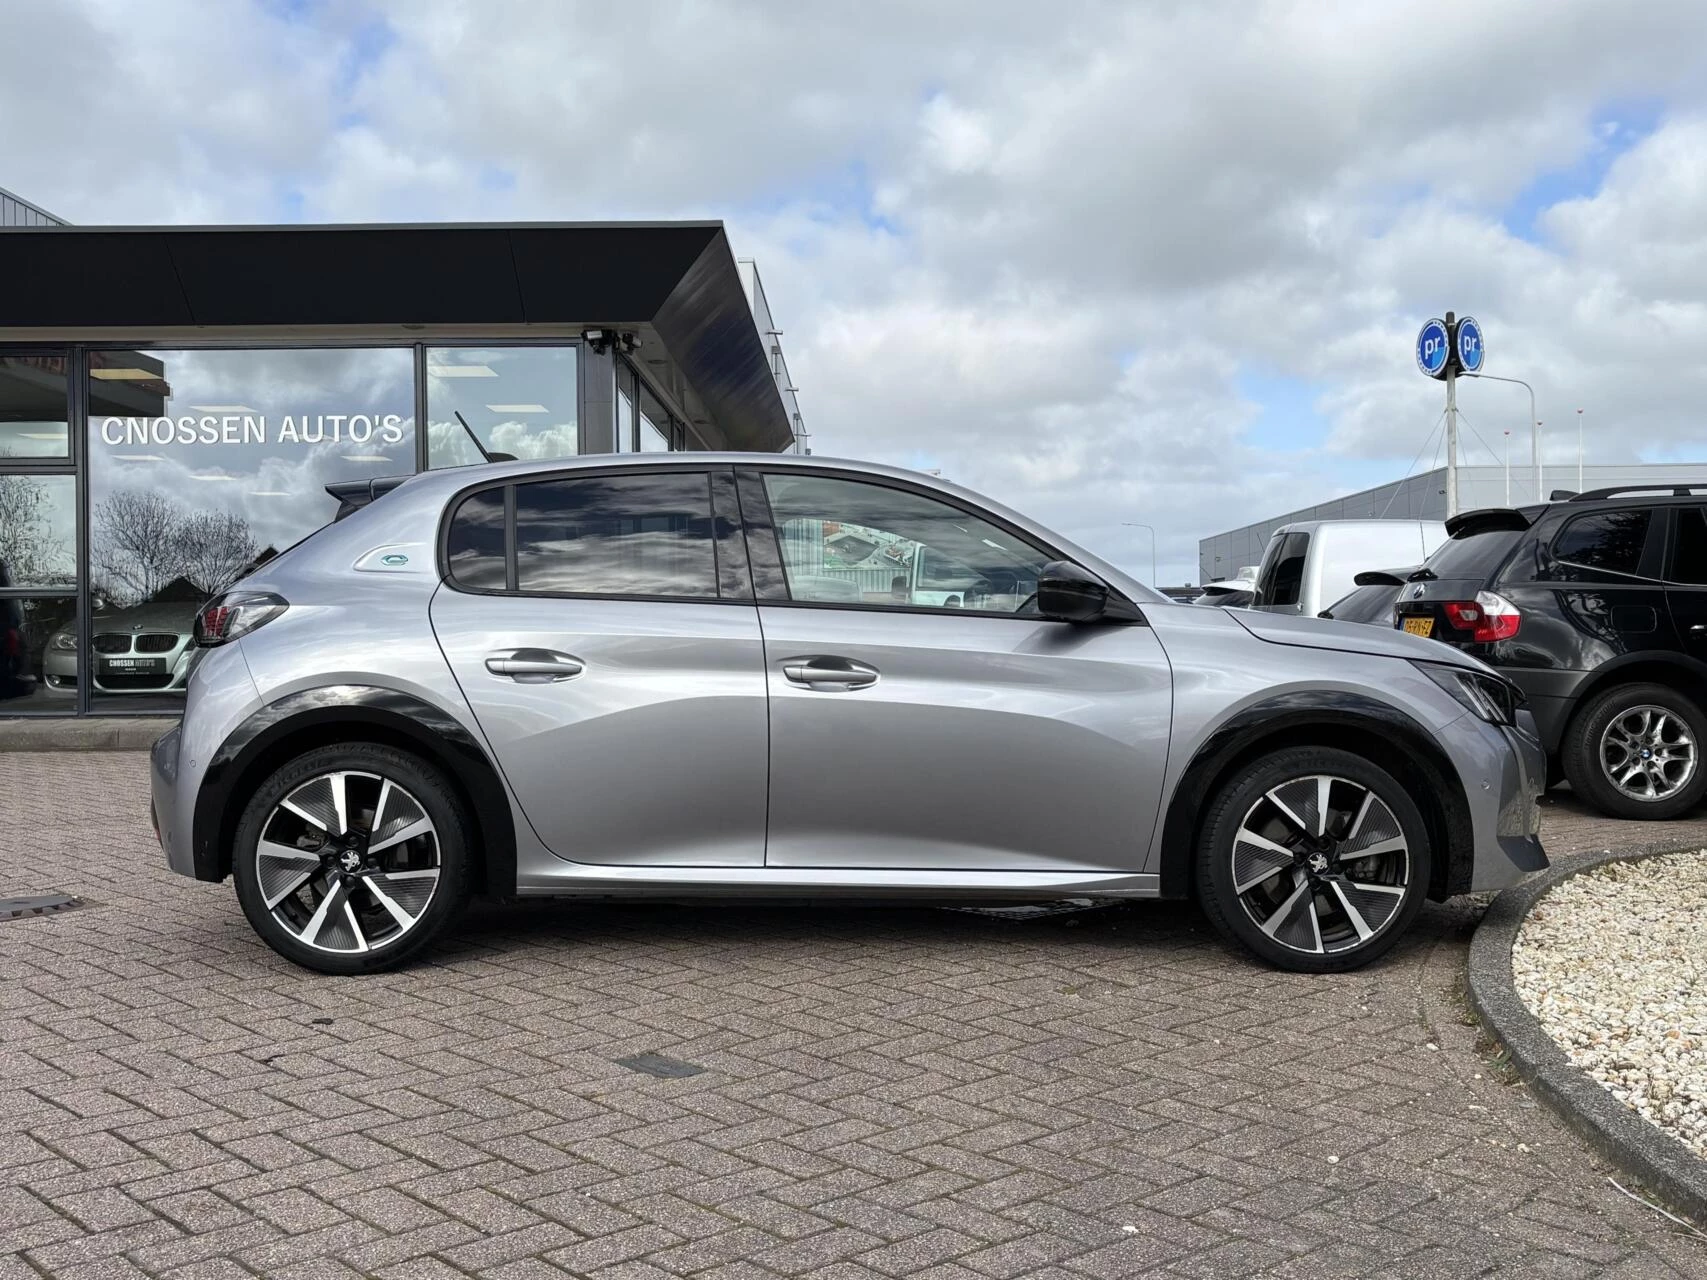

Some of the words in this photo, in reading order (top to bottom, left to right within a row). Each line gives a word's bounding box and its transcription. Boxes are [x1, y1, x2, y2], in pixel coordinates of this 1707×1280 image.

[1425, 336, 1440, 360] pr
[1464, 336, 1477, 355] pr
[101, 416, 266, 444] CNOSSEN
[278, 415, 402, 442] AUTO'S
[109, 659, 134, 667] CNOSSEN
